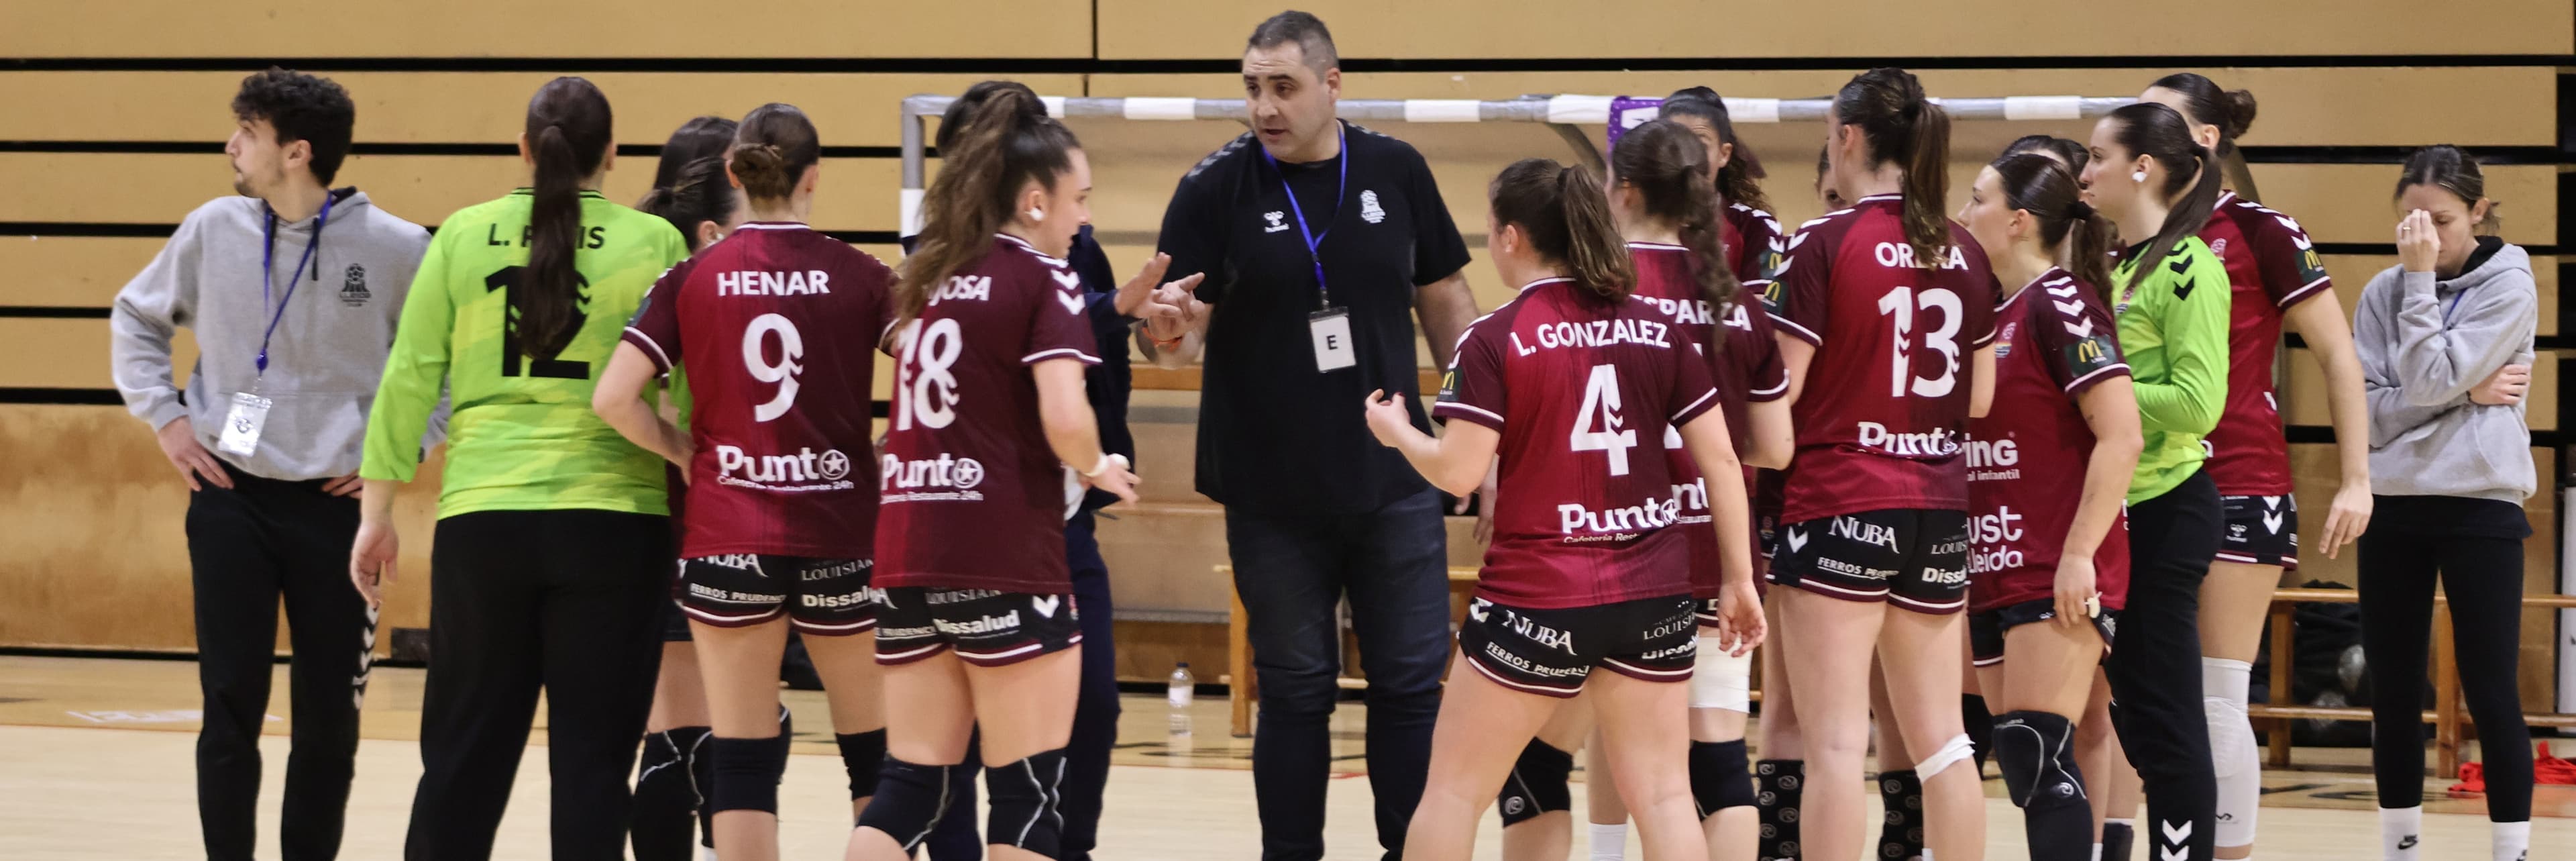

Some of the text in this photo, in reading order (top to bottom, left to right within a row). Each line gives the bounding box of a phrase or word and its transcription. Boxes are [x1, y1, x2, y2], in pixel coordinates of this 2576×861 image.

[488, 223, 511, 246] L.
[716, 270, 831, 297] HENAR
[1326, 335, 1338, 350] E
[1510, 318, 1671, 357] L. GONZALEZ
[1878, 286, 1963, 398] 13
[743, 313, 804, 422] 9
[896, 317, 963, 430] 18
[1570, 364, 1638, 476] 4
[1827, 515, 1900, 554] NUBA
[1818, 556, 1862, 575] FERROS
[1501, 609, 1578, 656] NUBA
[1487, 640, 1532, 670] FERROS
